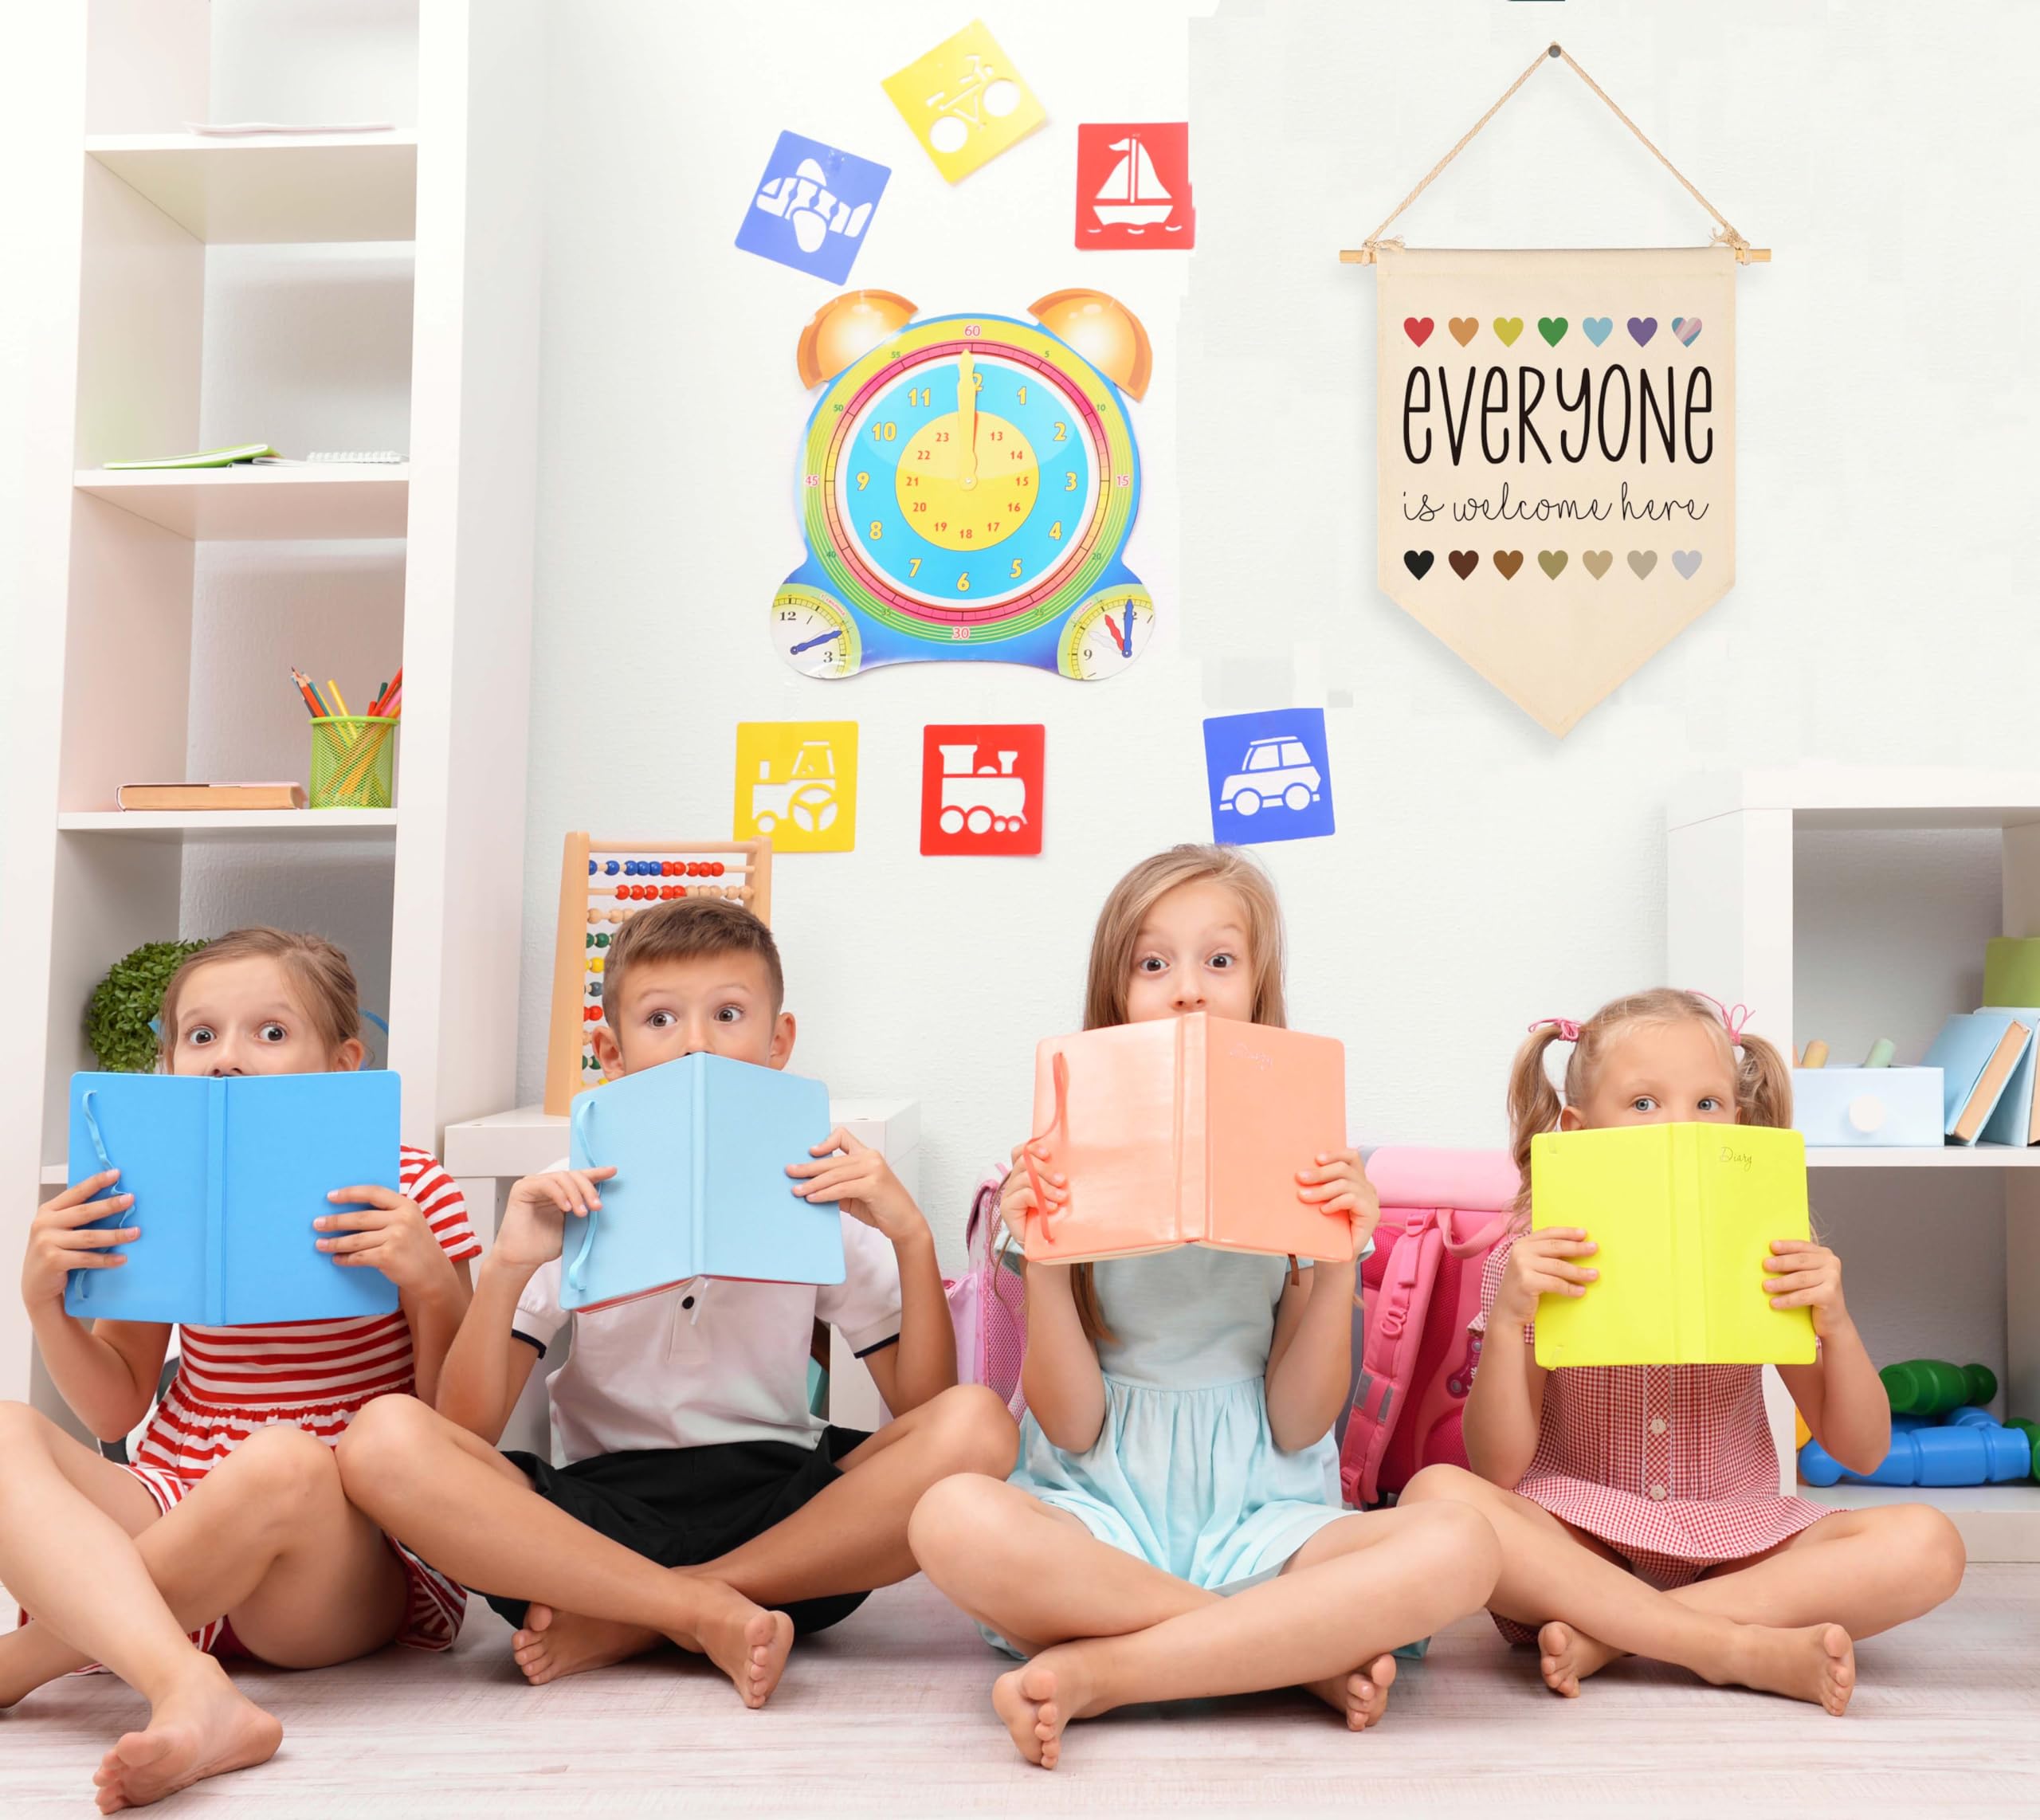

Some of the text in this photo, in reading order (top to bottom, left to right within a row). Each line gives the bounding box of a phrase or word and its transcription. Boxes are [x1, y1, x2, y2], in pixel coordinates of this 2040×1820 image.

[964, 325, 981, 337] 60
[908, 387, 931, 407] 11
[1017, 386, 1027, 406] 1
[872, 422, 896, 441] 10
[936, 433, 949, 442] 23
[991, 432, 1002, 441] 13
[1053, 422, 1067, 441] 2
[917, 451, 931, 460] 22
[1010, 451, 1023, 460] 14
[806, 476, 818, 488] 45
[856, 472, 870, 491] 9
[906, 477, 919, 486] 21
[1016, 477, 1029, 486] 15
[1065, 472, 1077, 492] 3
[1116, 476, 1129, 486] 15
[912, 502, 927, 512] 20
[1008, 503, 1021, 512] 16
[1402, 481, 1709, 522] is welcome here
[869, 520, 883, 540] 8
[934, 522, 947, 532] 19
[987, 522, 1000, 531] 17
[1048, 520, 1062, 540] 4
[960, 529, 972, 539] 18
[908, 559, 923, 578] 7
[1010, 559, 1023, 578] 5
[956, 571, 971, 591] 6
[780, 611, 796, 621] 12
[1035, 608, 1045, 617] 25
[952, 627, 970, 640] 30
[823, 651, 833, 663] 3
[1084, 649, 1093, 661] 9
[1720, 1147, 1752, 1172] Diary
